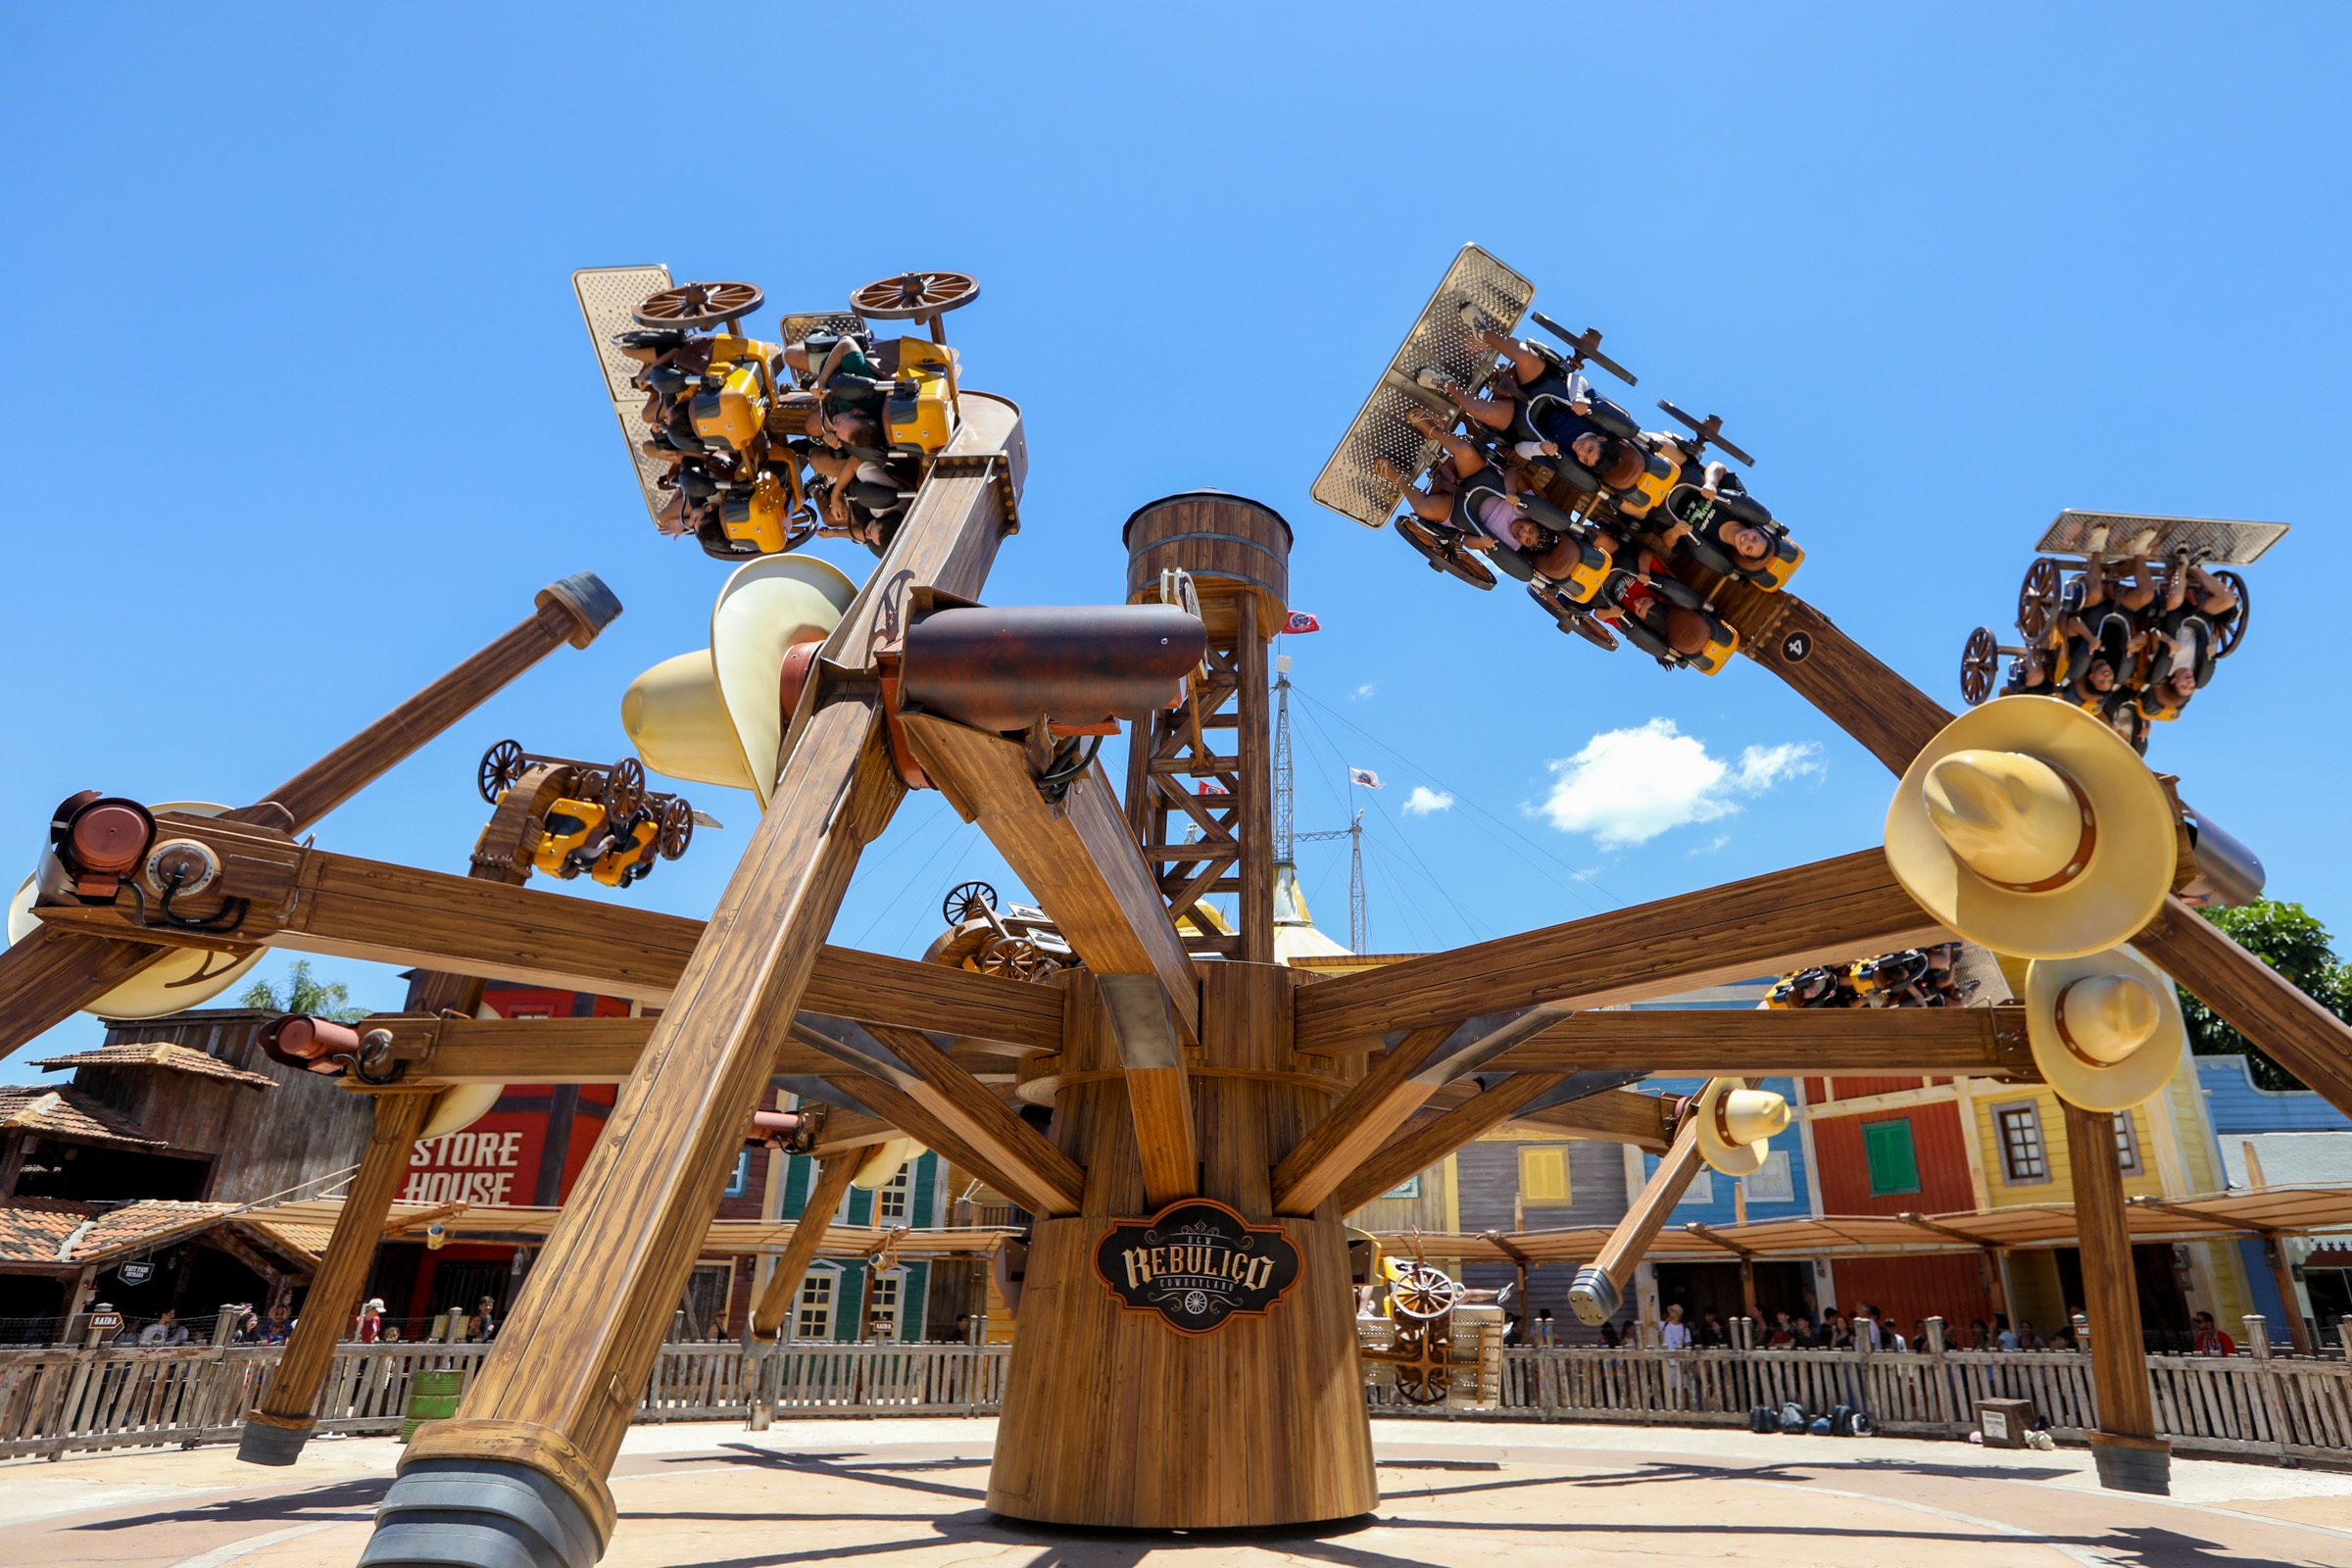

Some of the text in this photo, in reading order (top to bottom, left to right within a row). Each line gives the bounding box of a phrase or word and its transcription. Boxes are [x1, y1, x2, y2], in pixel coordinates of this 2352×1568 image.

[1788, 639, 1803, 656] 4
[410, 1132, 523, 1166] STORE
[403, 1172, 514, 1206] HOUSE
[1188, 1235, 1212, 1246] BCW
[1121, 1246, 1276, 1291] REBULIÇO
[1159, 1279, 1234, 1292] COWBOYLAND
[94, 1315, 117, 1325] SAÍDA
